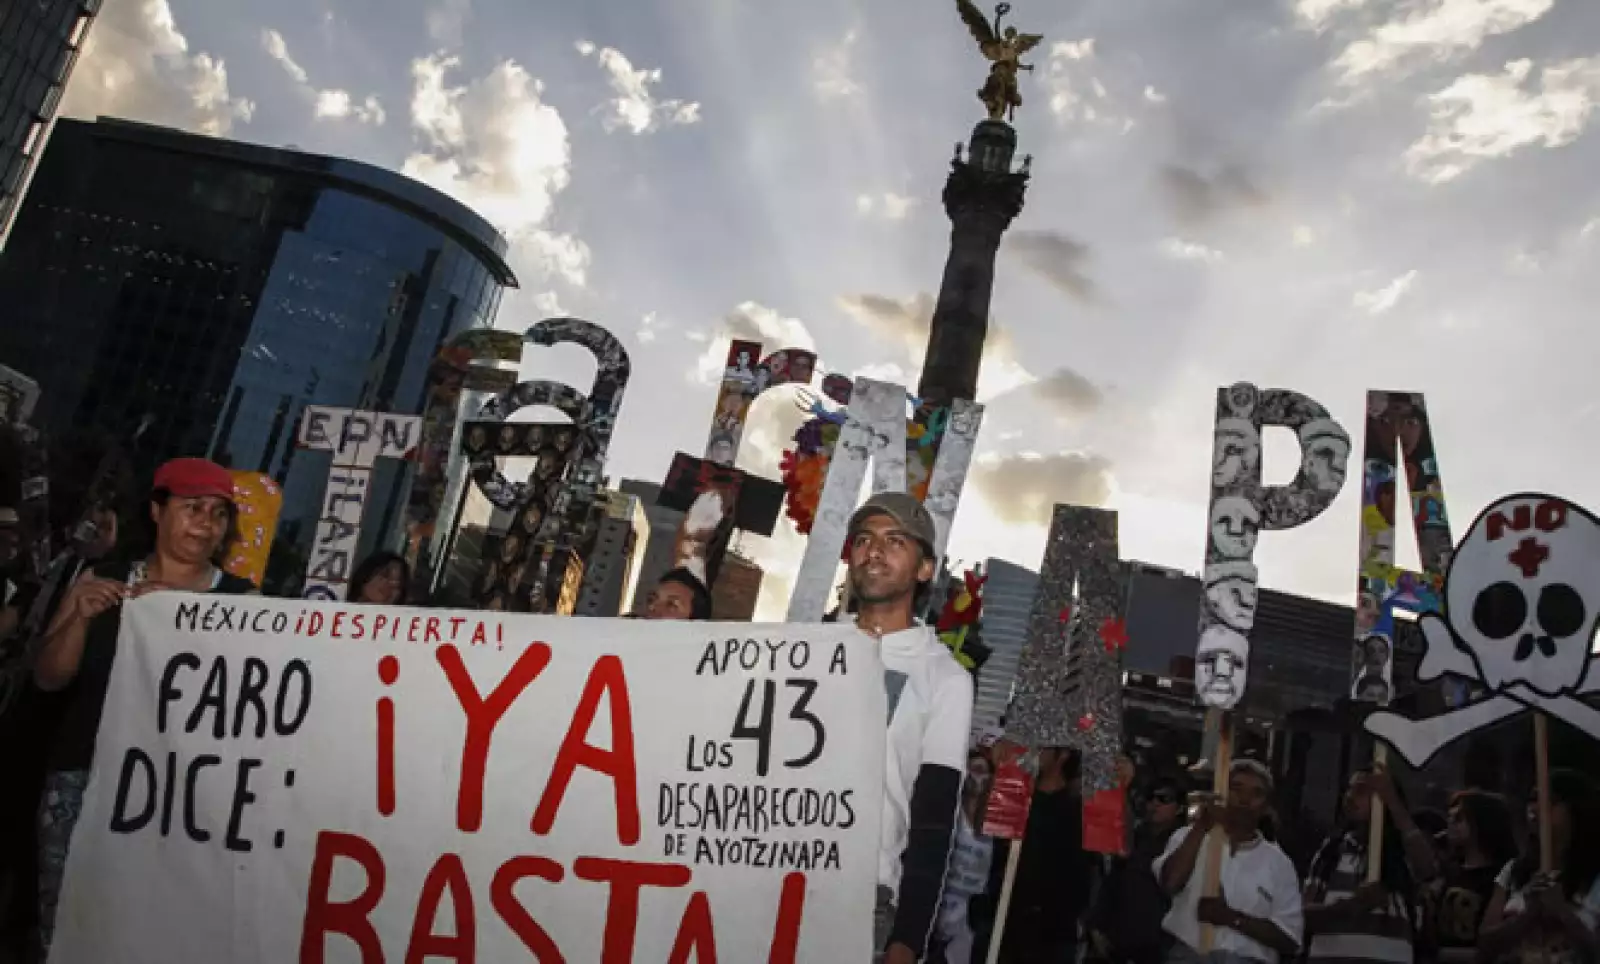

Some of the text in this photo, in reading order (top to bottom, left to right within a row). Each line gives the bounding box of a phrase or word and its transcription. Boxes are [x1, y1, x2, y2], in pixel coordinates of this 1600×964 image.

[306, 411, 413, 453] EPN
[1485, 499, 1567, 541] NO
[175, 601, 288, 633] MÉXICO
[696, 639, 847, 676] APOYO A
[157, 652, 312, 738] FARO
[731, 678, 826, 777] 43
[109, 746, 295, 851] DICE:
[658, 782, 855, 833] DESAPARECIDOS
[664, 833, 841, 870] DE AYOTZINAPA
